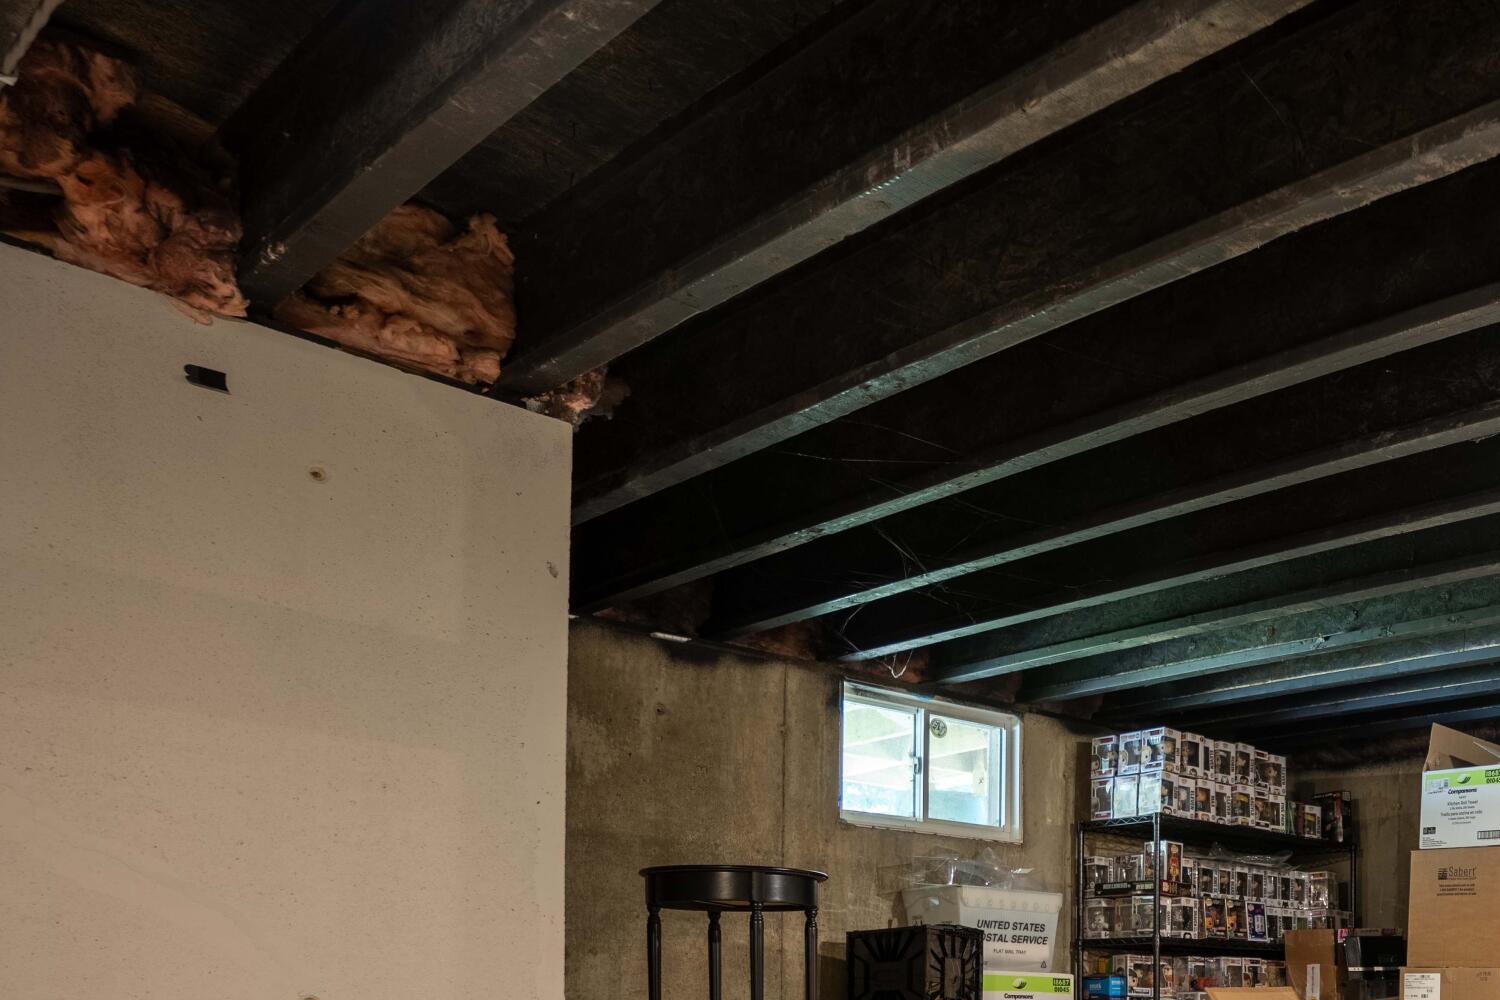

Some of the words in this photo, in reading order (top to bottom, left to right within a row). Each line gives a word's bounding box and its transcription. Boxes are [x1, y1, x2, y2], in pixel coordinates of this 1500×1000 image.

[1448, 866, 1477, 877] Sabert
[976, 919, 1010, 930] UNITED
[1012, 921, 1046, 932] STATES
[981, 932, 1009, 943] OSTAL
[1010, 935, 1048, 945] SERVICE
